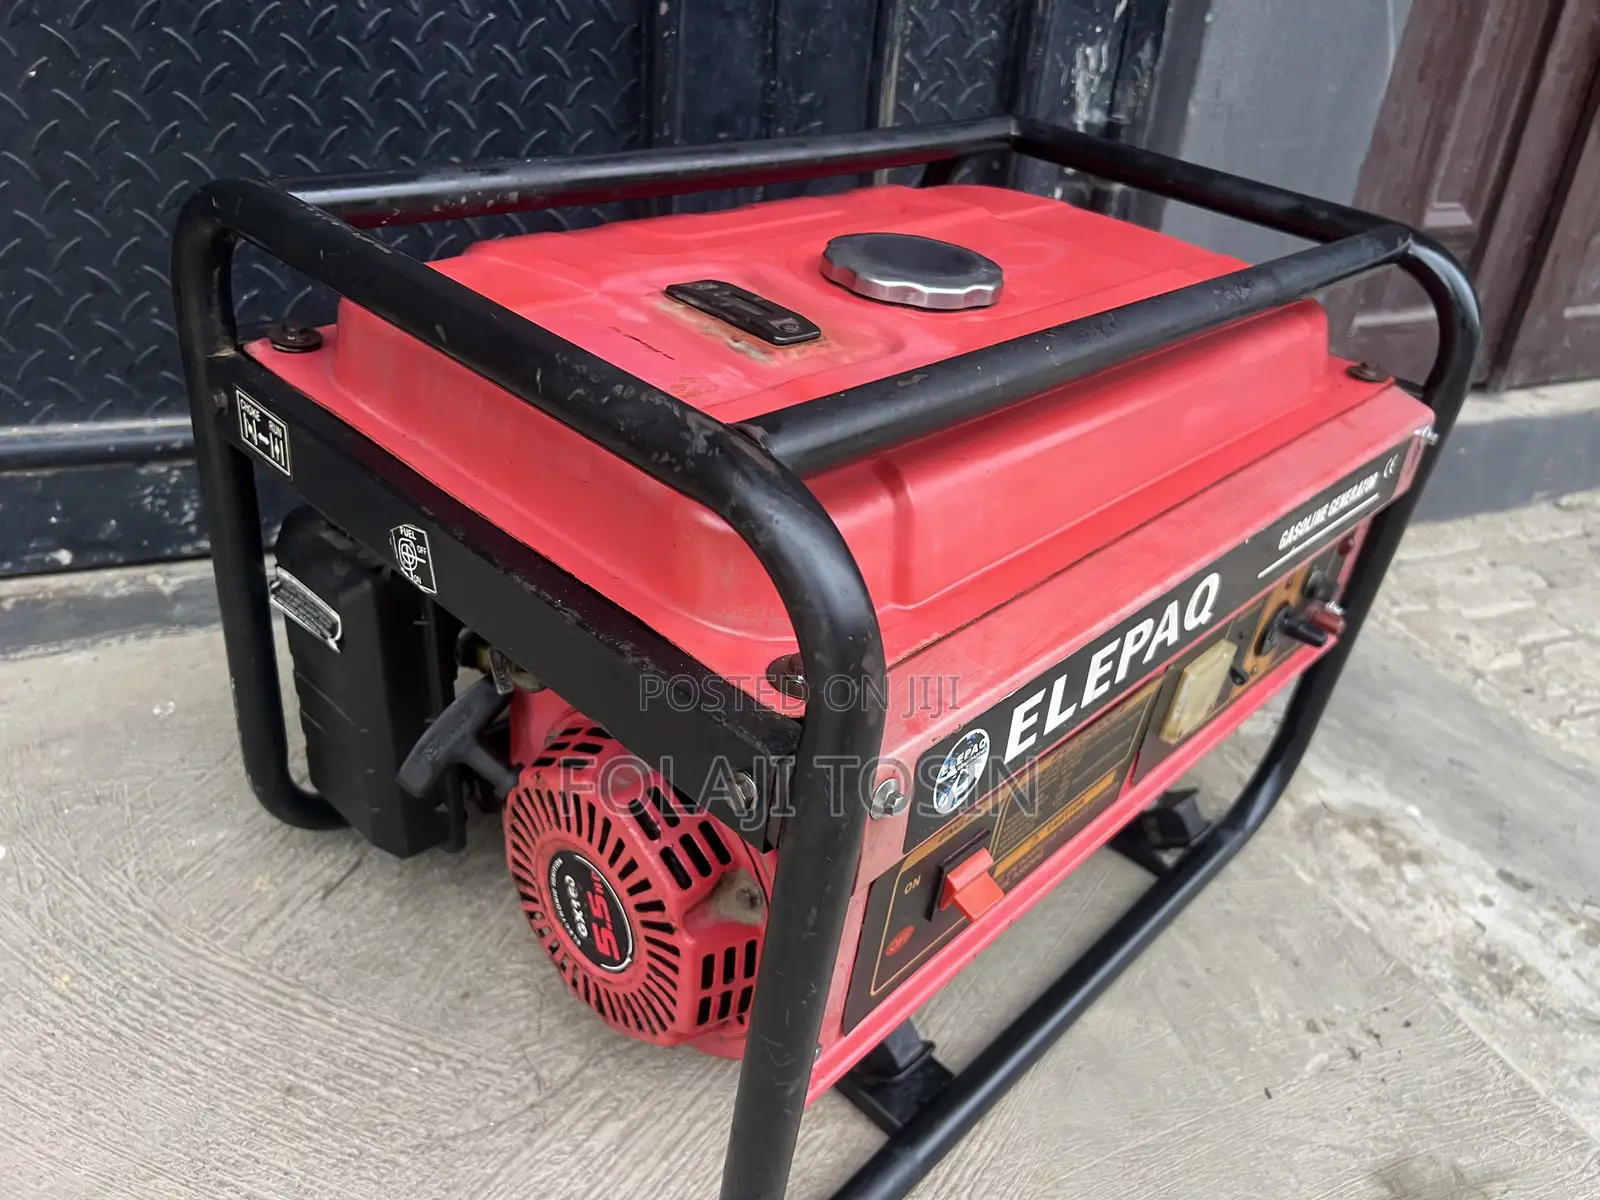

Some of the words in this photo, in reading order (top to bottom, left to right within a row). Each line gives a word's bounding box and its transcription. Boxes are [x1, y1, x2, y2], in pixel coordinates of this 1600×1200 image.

[240, 398, 261, 423] CHOKE
[268, 420, 282, 439] RUN
[1278, 502, 1330, 551] GASOLINE
[1327, 470, 1379, 518] GENERATOR
[400, 525, 417, 541] FUEL
[416, 544, 427, 555] OFF
[1003, 572, 1220, 765] ELEPAQ
[939, 739, 987, 779] ELEPAQ
[549, 857, 564, 887] IGNITION
[904, 874, 922, 895] ON
[551, 887, 582, 946] ELECTRONIC
